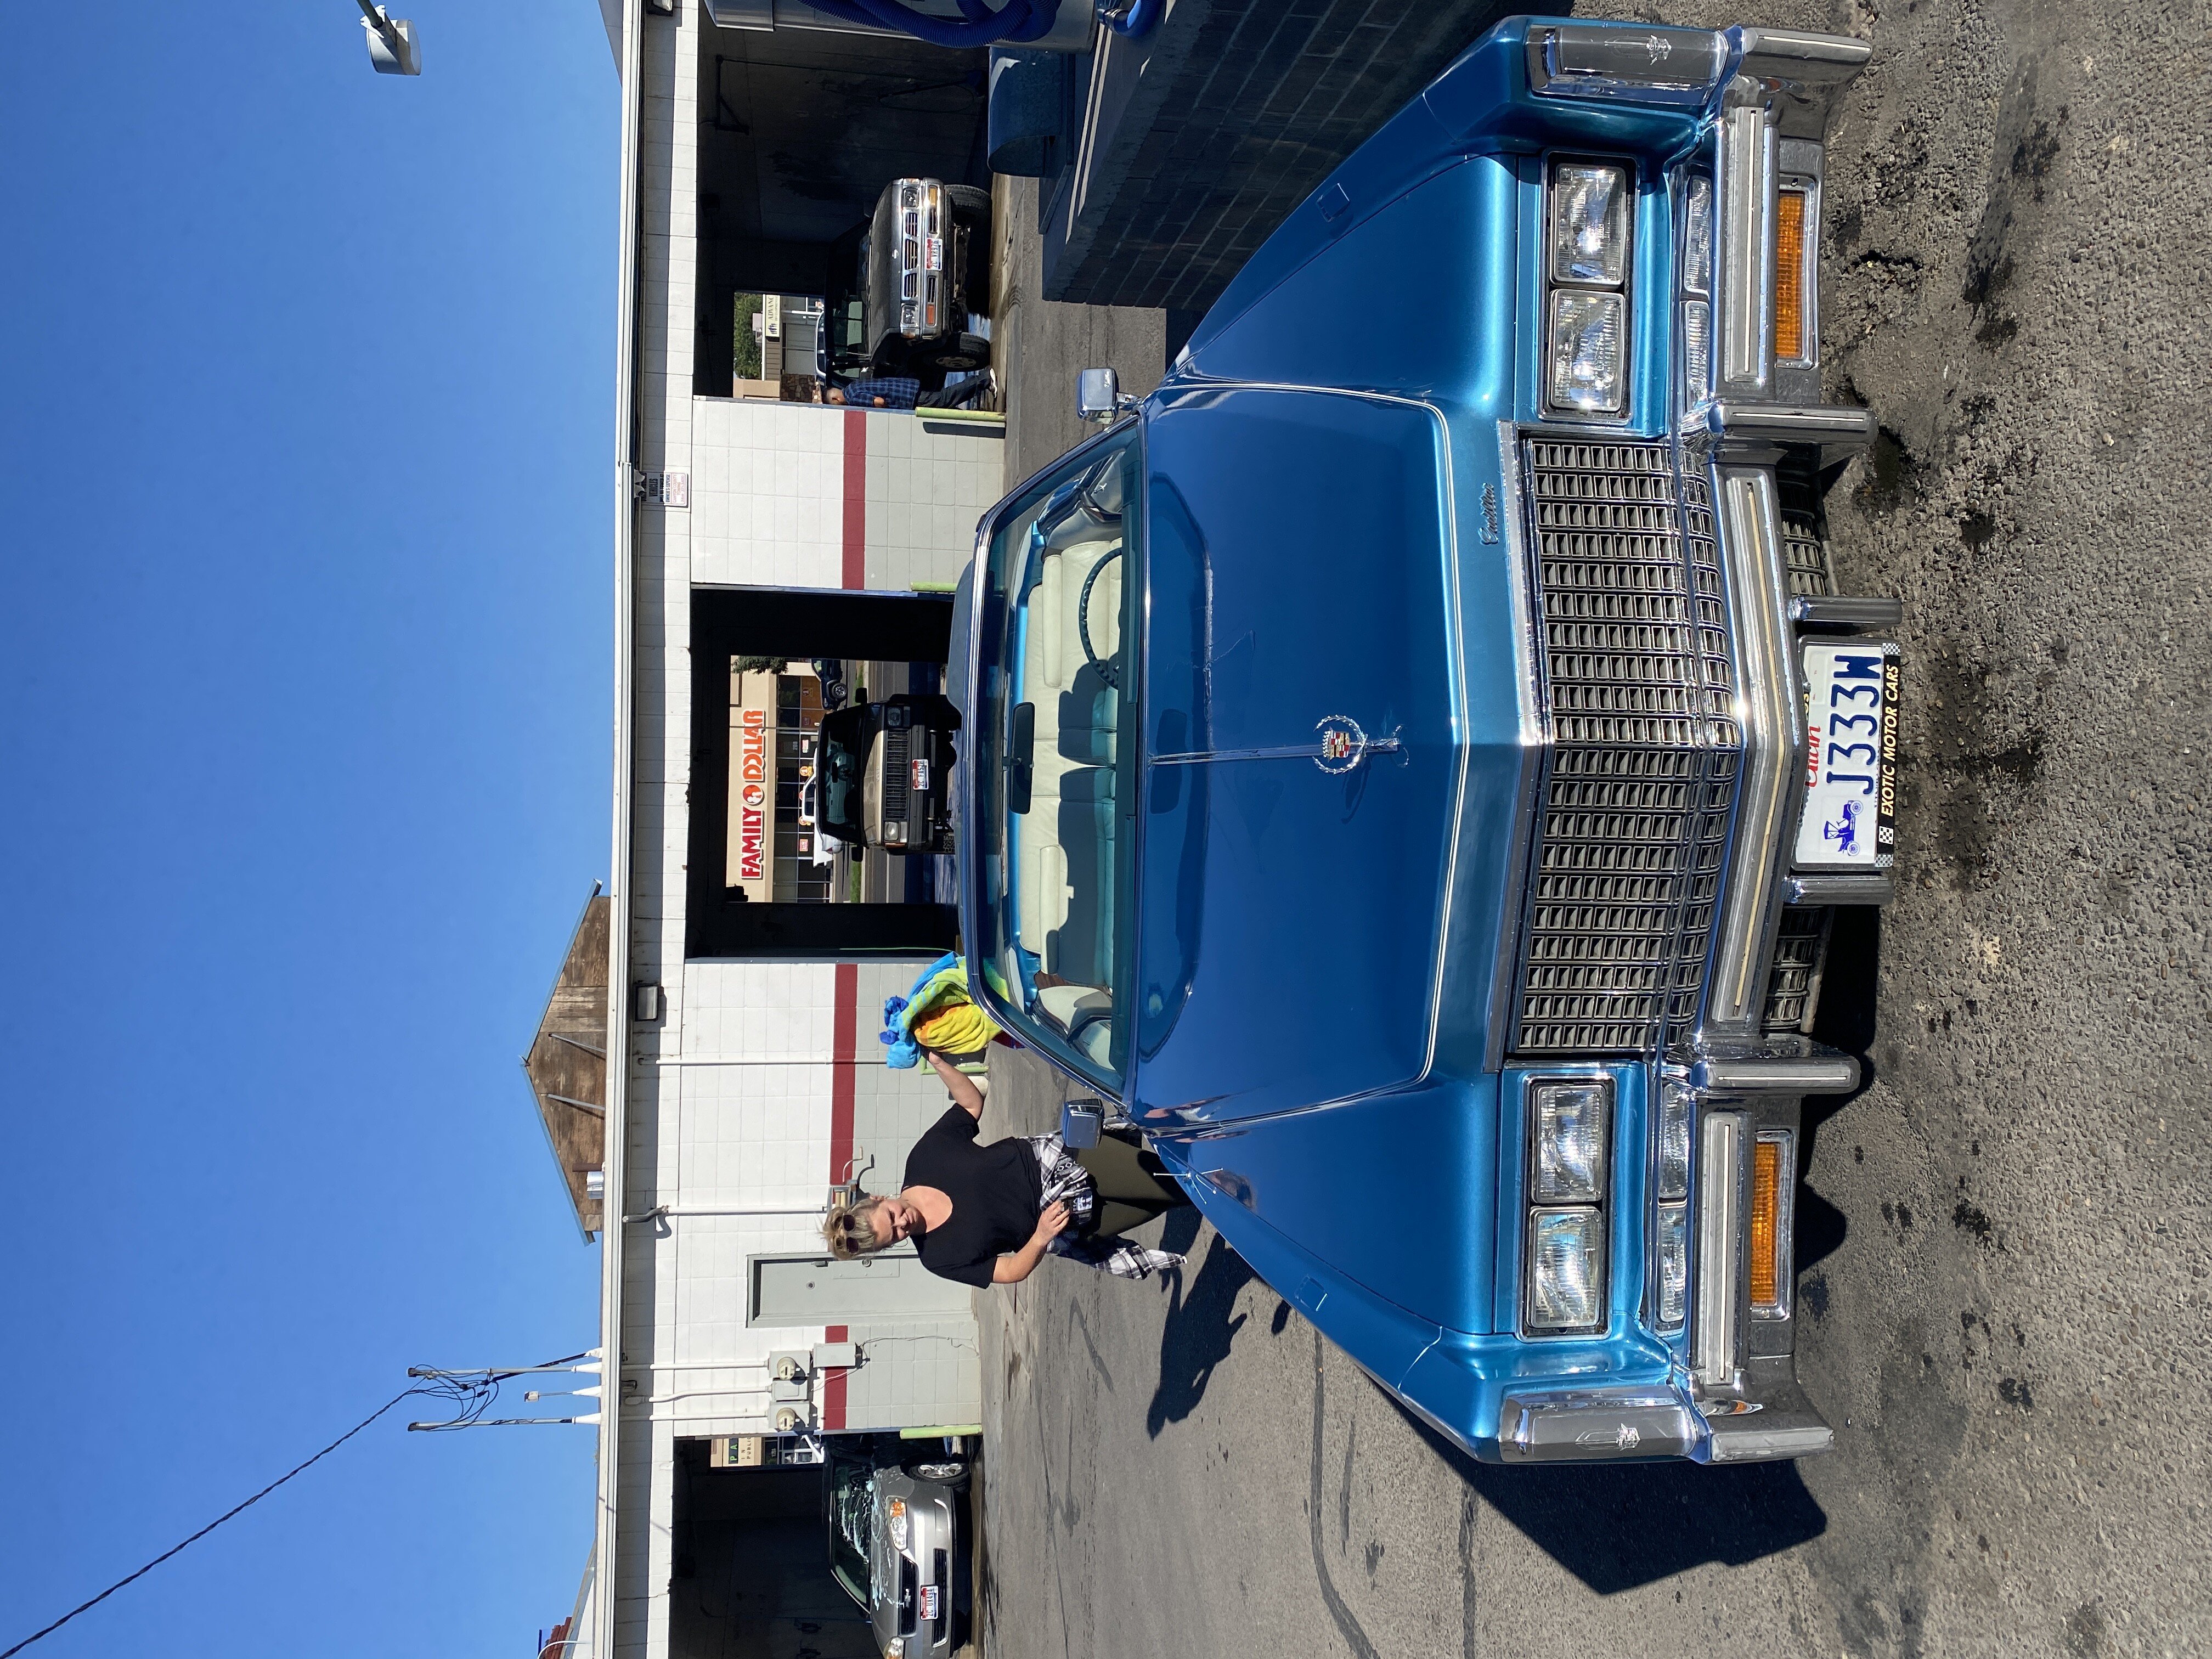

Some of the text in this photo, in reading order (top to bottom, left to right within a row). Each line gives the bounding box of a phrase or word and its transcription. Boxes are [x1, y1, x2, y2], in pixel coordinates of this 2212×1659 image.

[741, 709, 763, 878] FAMILY DOLLAR
[1826, 654, 1881, 795] J333W
[1881, 664, 1899, 817] EXOTIC MOTOR CARS
